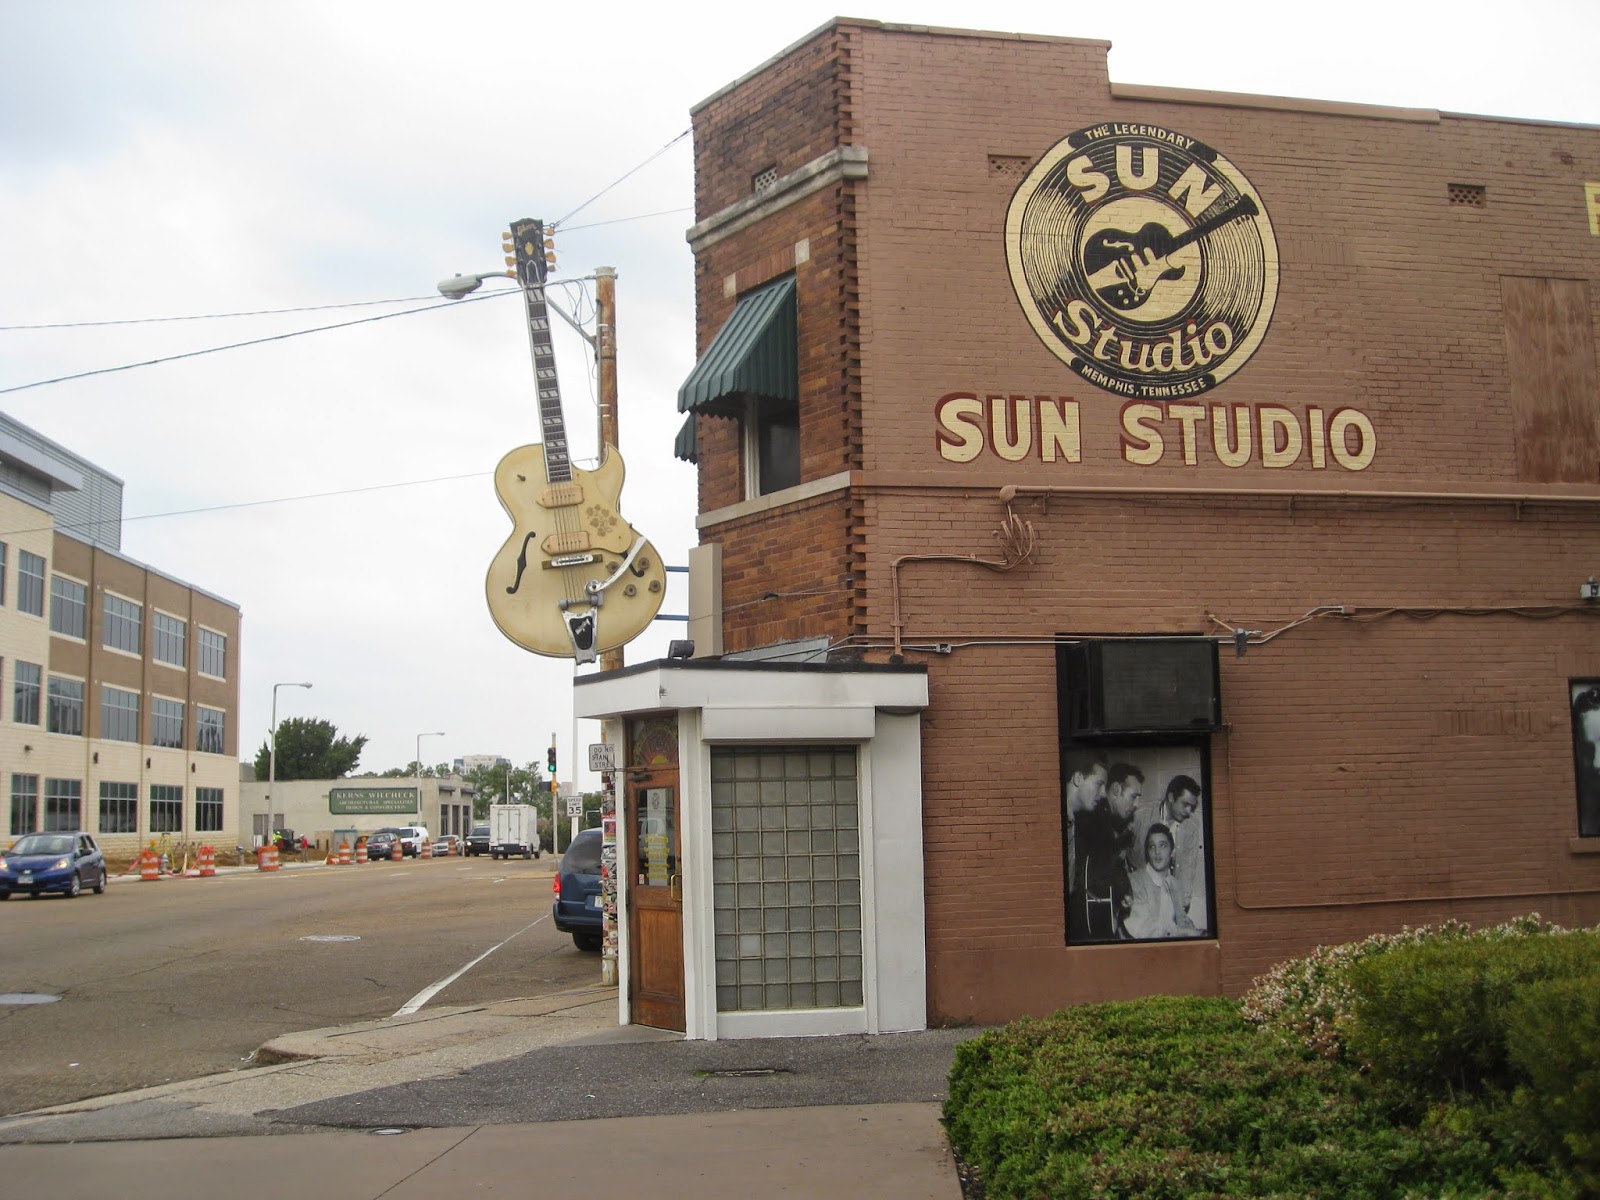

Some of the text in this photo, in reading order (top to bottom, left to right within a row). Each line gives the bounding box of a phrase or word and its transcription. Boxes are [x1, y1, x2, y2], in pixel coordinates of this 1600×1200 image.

[1084, 123, 1195, 150] THE LEGENDARY
[1067, 144, 1224, 219] SUN
[1051, 298, 1234, 372] Studio
[1081, 364, 1207, 397] MEMPHIS, TENNESSEE
[934, 392, 1378, 472] SUN STUDIO
[568, 806, 582, 815] 35
